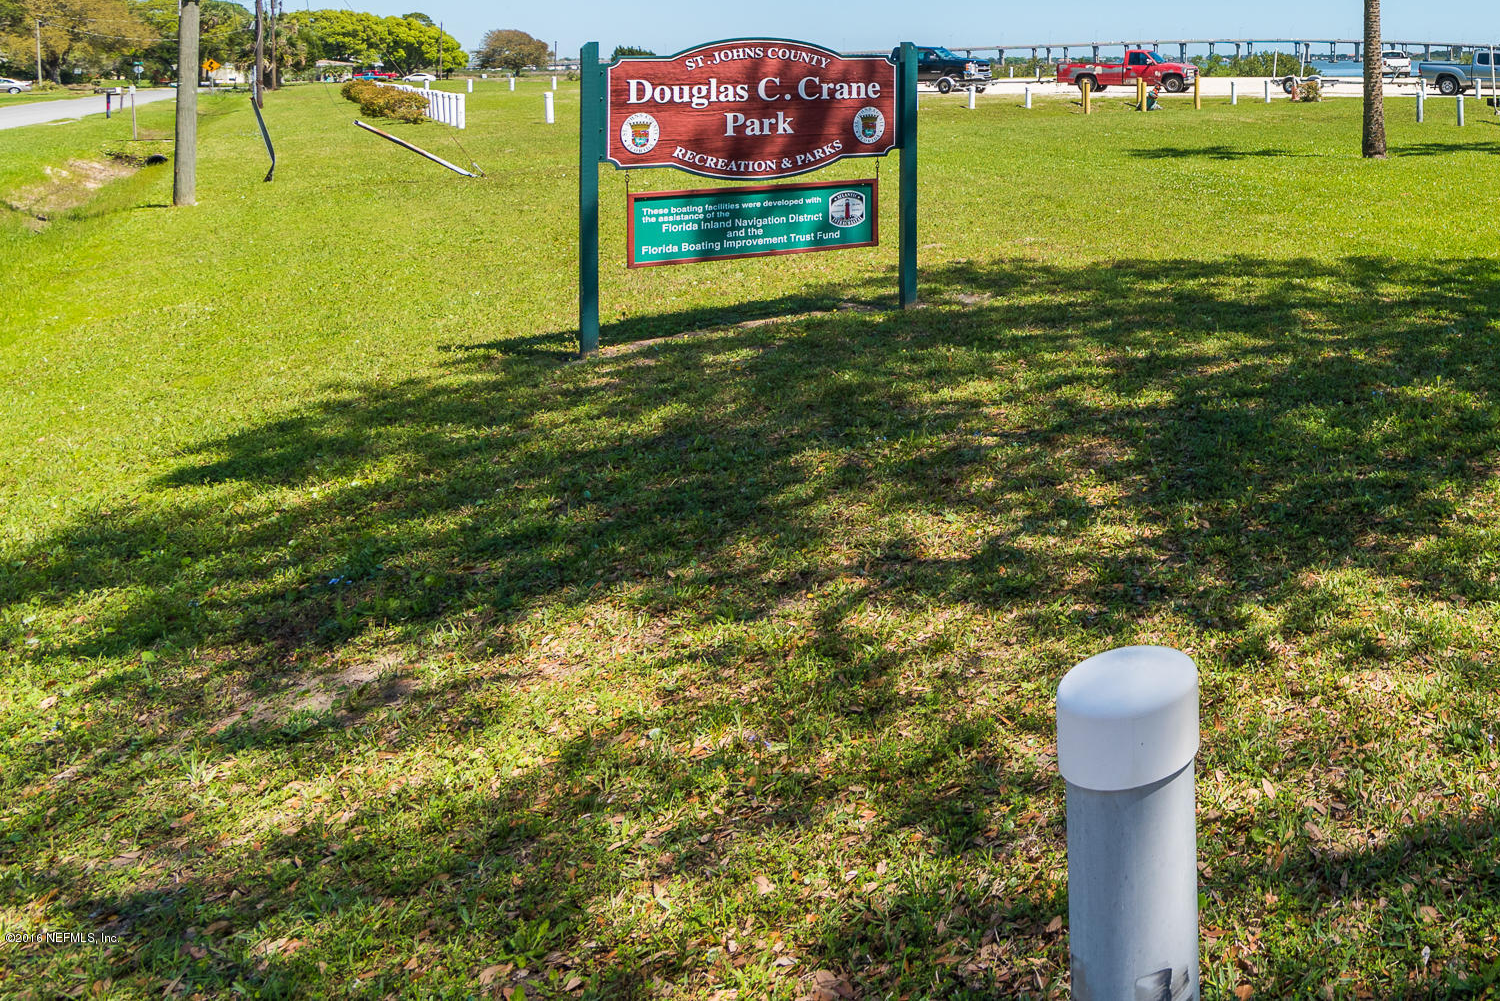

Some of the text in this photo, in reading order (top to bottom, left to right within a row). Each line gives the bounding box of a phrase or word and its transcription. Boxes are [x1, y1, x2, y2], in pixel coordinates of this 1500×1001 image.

[713, 47, 763, 65] JOHNS
[767, 48, 832, 69] COUNTY
[627, 77, 881, 108] Douglas C. Crane
[724, 112, 794, 136] Park
[672, 139, 843, 172] RECREATION & PARKS
[642, 208, 668, 216] These
[671, 205, 703, 214] boating
[705, 203, 739, 211] facilities
[763, 199, 804, 207] developed
[658, 213, 704, 222] assistance
[662, 223, 698, 233] Florida
[701, 220, 731, 229] Inland
[735, 216, 786, 228] Navigation
[789, 213, 822, 223] District
[727, 227, 763, 238] and the
[642, 230, 840, 255] Florida Boating Improvement Trust Fund
